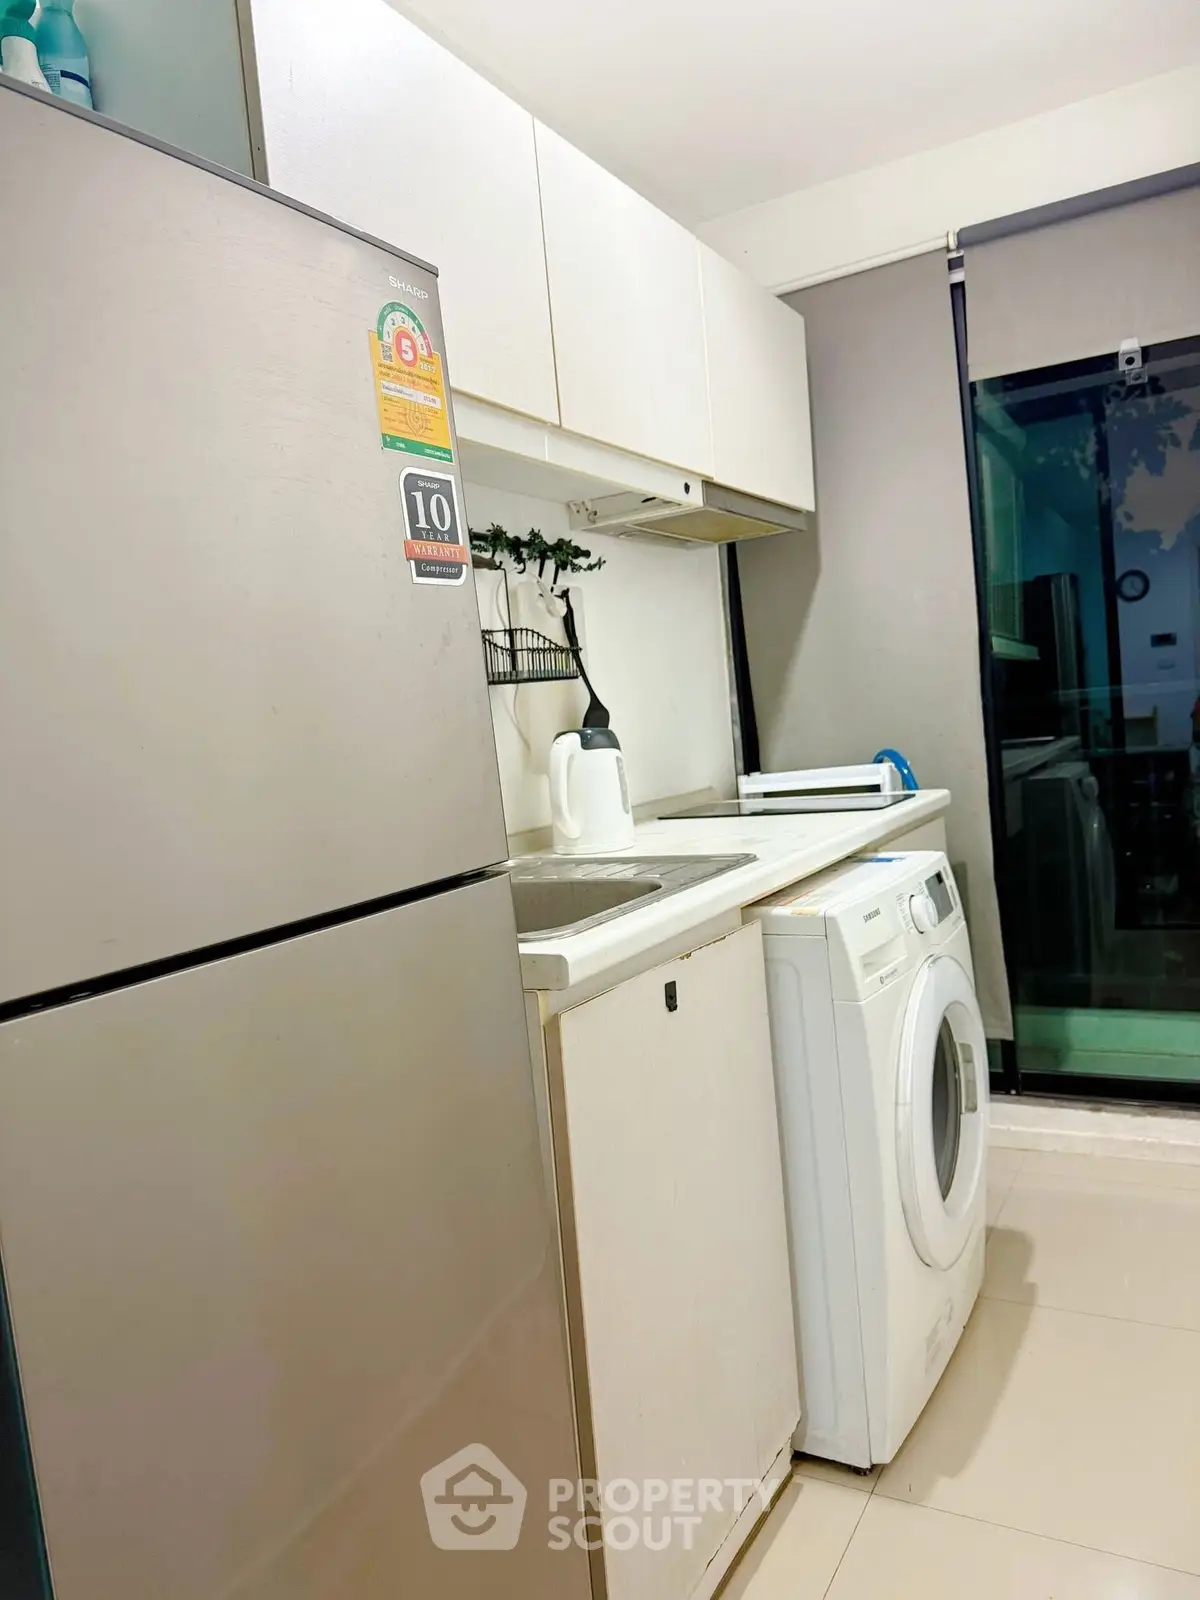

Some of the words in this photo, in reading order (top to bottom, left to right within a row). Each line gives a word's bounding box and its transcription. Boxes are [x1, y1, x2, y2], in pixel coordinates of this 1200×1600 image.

[389, 275, 428, 299] SHARP
[400, 337, 414, 362] 5
[417, 480, 440, 490] SHARP
[410, 490, 451, 532] 10
[421, 530, 450, 543] YEAR
[412, 543, 461, 560] WARRANTY
[421, 562, 459, 575] Compressor
